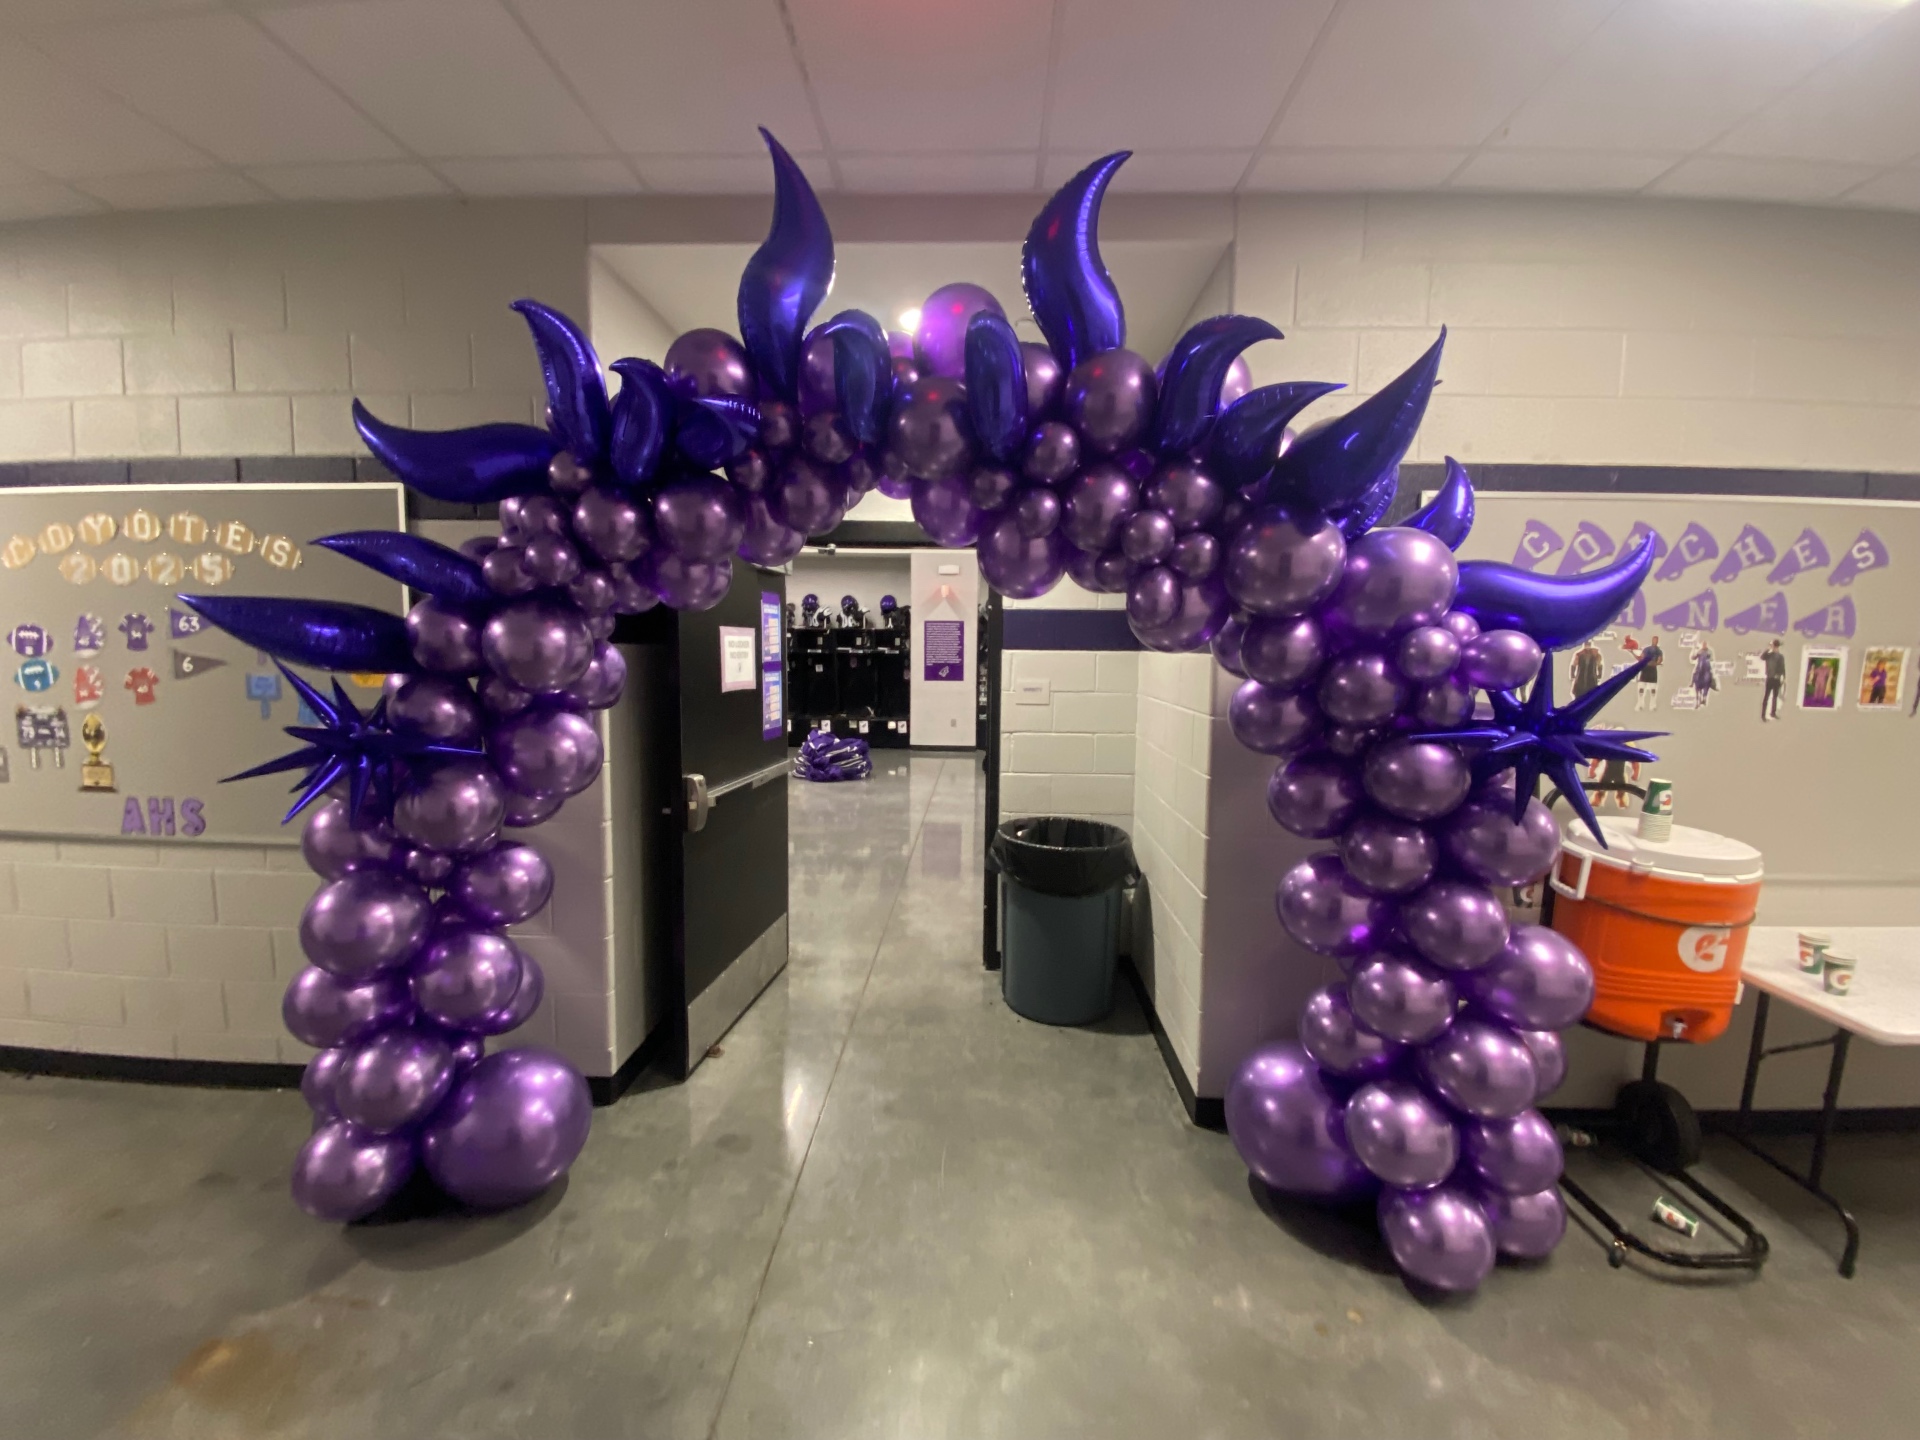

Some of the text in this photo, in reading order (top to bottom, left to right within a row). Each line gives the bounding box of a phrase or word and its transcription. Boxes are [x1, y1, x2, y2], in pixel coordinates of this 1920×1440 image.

[8, 511, 291, 567] COYOTES
[69, 554, 223, 585] 2025
[178, 616, 200, 632] 63
[182, 656, 193, 672] 6
[121, 796, 206, 836] AHS
[1677, 924, 1729, 973] G
